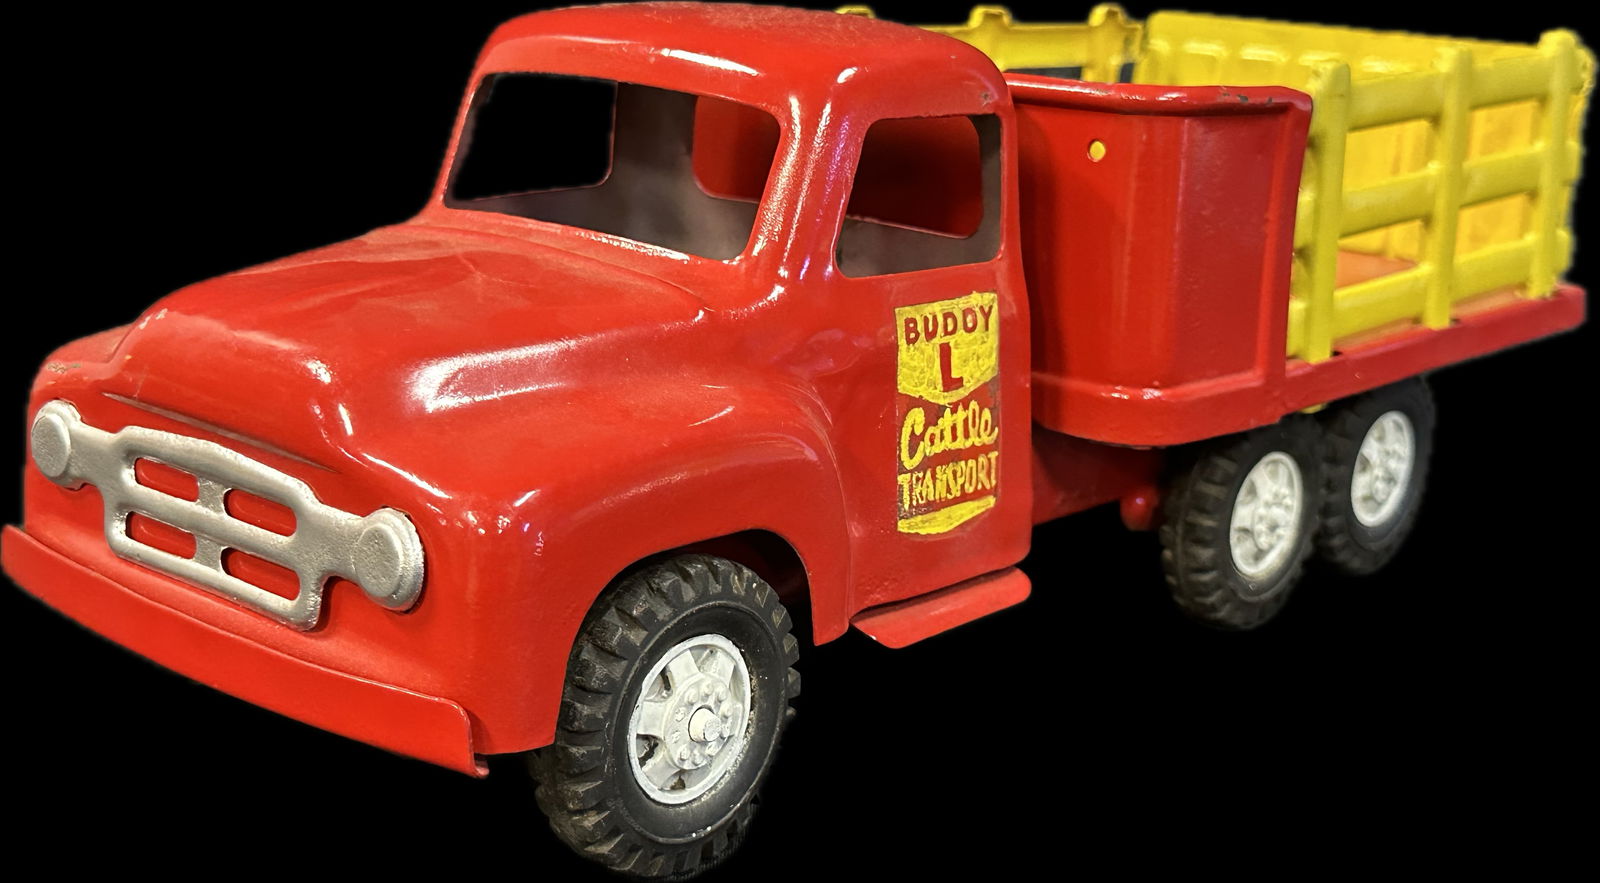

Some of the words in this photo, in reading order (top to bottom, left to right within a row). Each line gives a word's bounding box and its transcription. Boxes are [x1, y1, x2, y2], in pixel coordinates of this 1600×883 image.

[904, 305, 992, 345] BUDDY
[939, 342, 964, 392] L
[901, 400, 998, 470] Cattle
[898, 451, 998, 511] TRANSPORT
